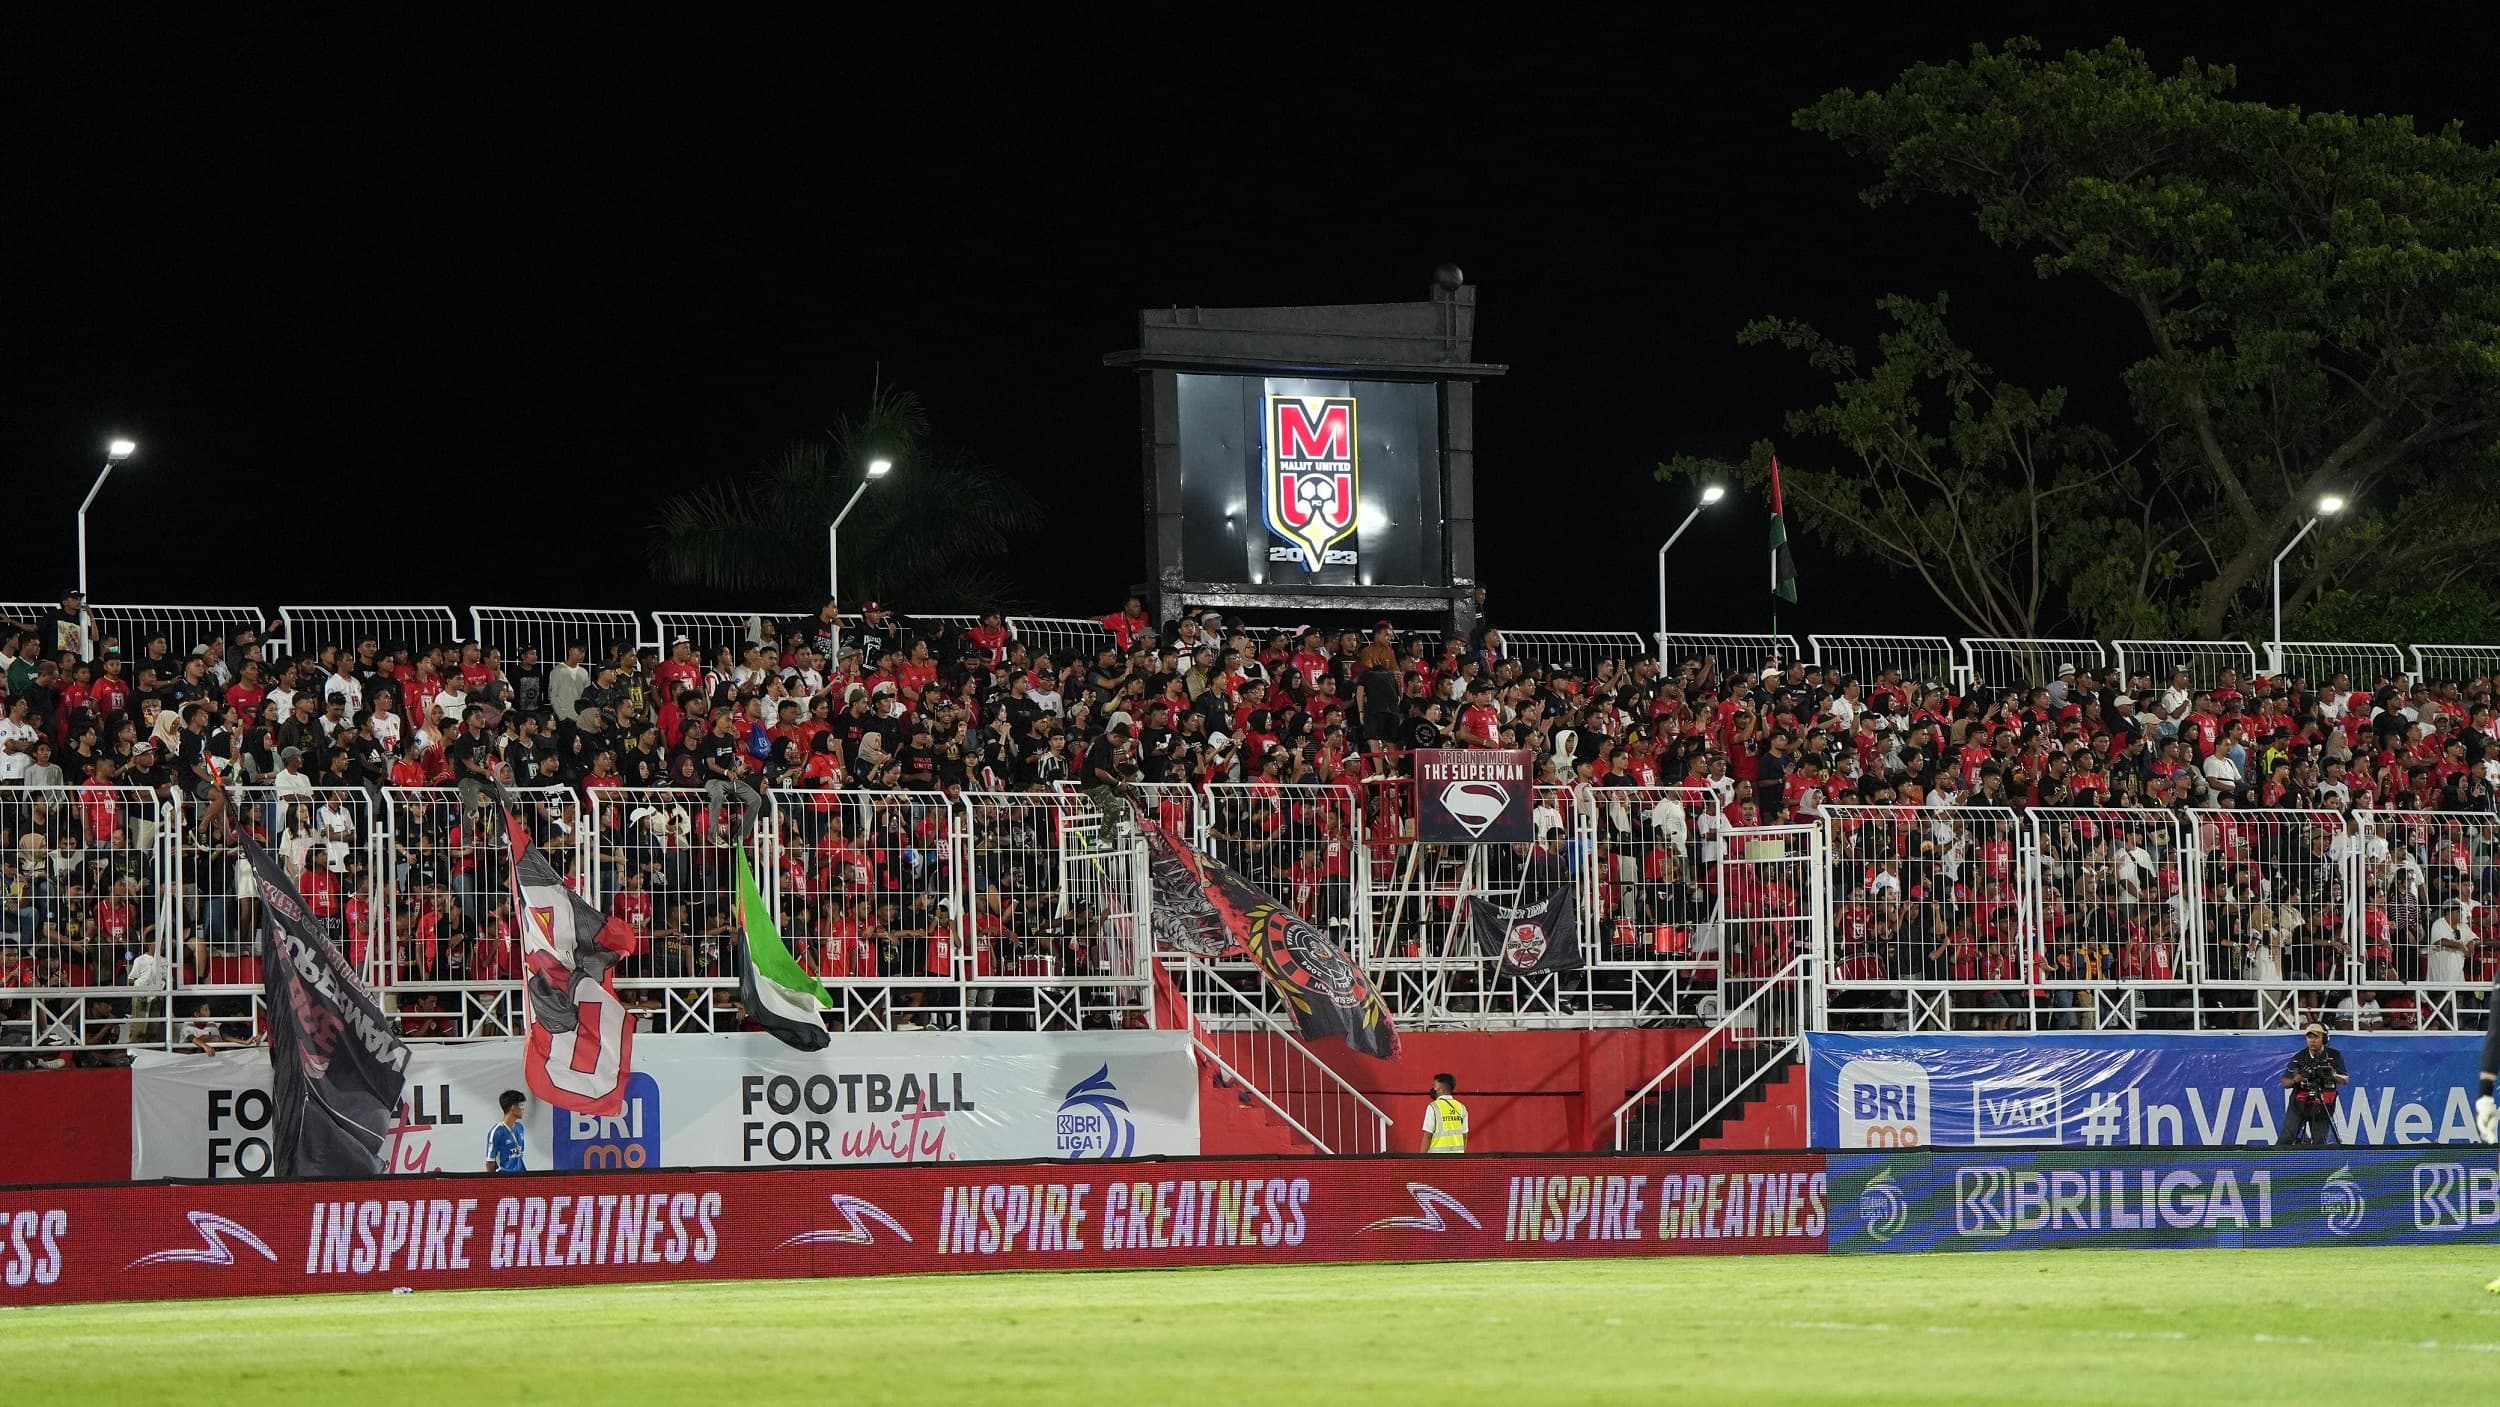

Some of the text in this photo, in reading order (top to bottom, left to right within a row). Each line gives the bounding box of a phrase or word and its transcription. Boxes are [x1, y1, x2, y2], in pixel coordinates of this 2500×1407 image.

[1280, 461, 1351, 472] MALUT UNITED
[1424, 764, 1524, 780] THE SUPERMAN
[1439, 750, 1512, 765] TRIBUN TIMUR
[742, 1072, 975, 1116] FOOTBALL
[1854, 1083, 1916, 1121] BRI
[1985, 1098, 2050, 1126] VAR
[570, 1098, 643, 1140] BRI
[743, 1120, 833, 1162] FOR
[1057, 1135, 1094, 1150] LIGA
[938, 1178, 1311, 1254] INSPIRE GREATNESS
[1505, 1175, 1647, 1241] INSPIRE
[306, 1192, 722, 1274] INSPIRE GREATNESS
